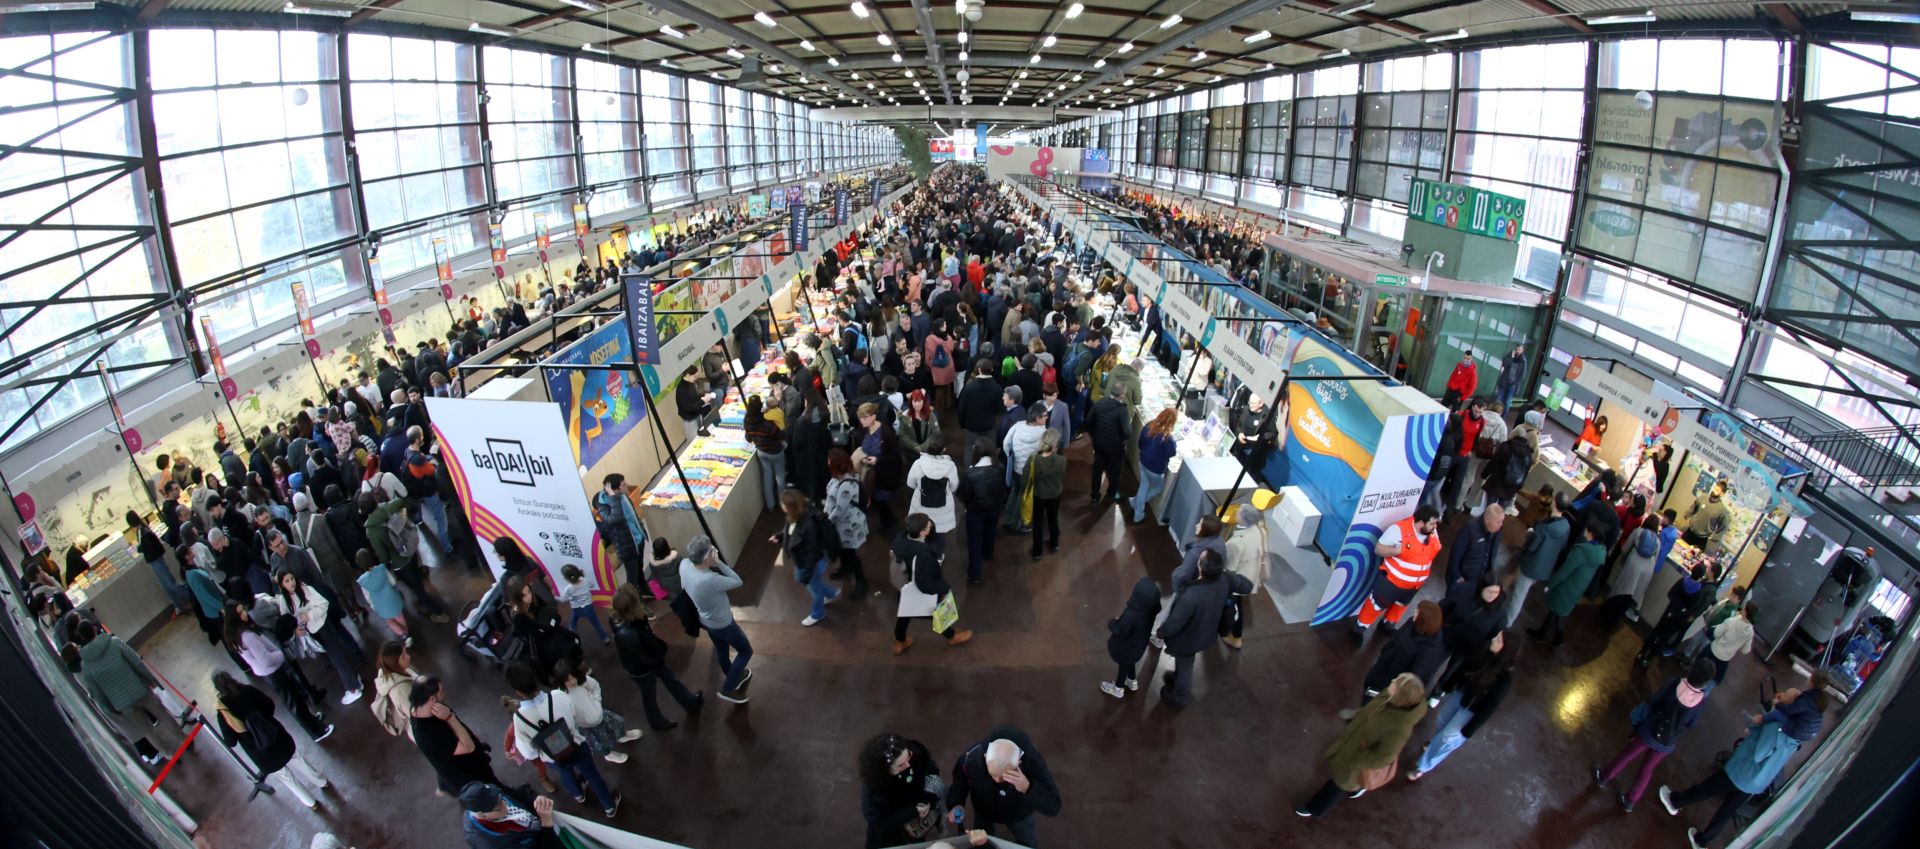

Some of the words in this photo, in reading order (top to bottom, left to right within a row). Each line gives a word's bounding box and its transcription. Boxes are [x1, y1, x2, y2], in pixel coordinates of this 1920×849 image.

[1410, 181, 1425, 216] 01
[1472, 192, 1489, 231] 01
[796, 207, 806, 245] IBAIZABAL
[638, 279, 649, 349] IBAIZABAL
[1691, 440, 1702, 452] ETA
[1701, 446, 1737, 474] MARIMOTOTS
[1715, 443, 1741, 463] PORROTX
[1377, 498, 1407, 510] JAIALDIA
[1380, 488, 1422, 502] KULTURAREN
